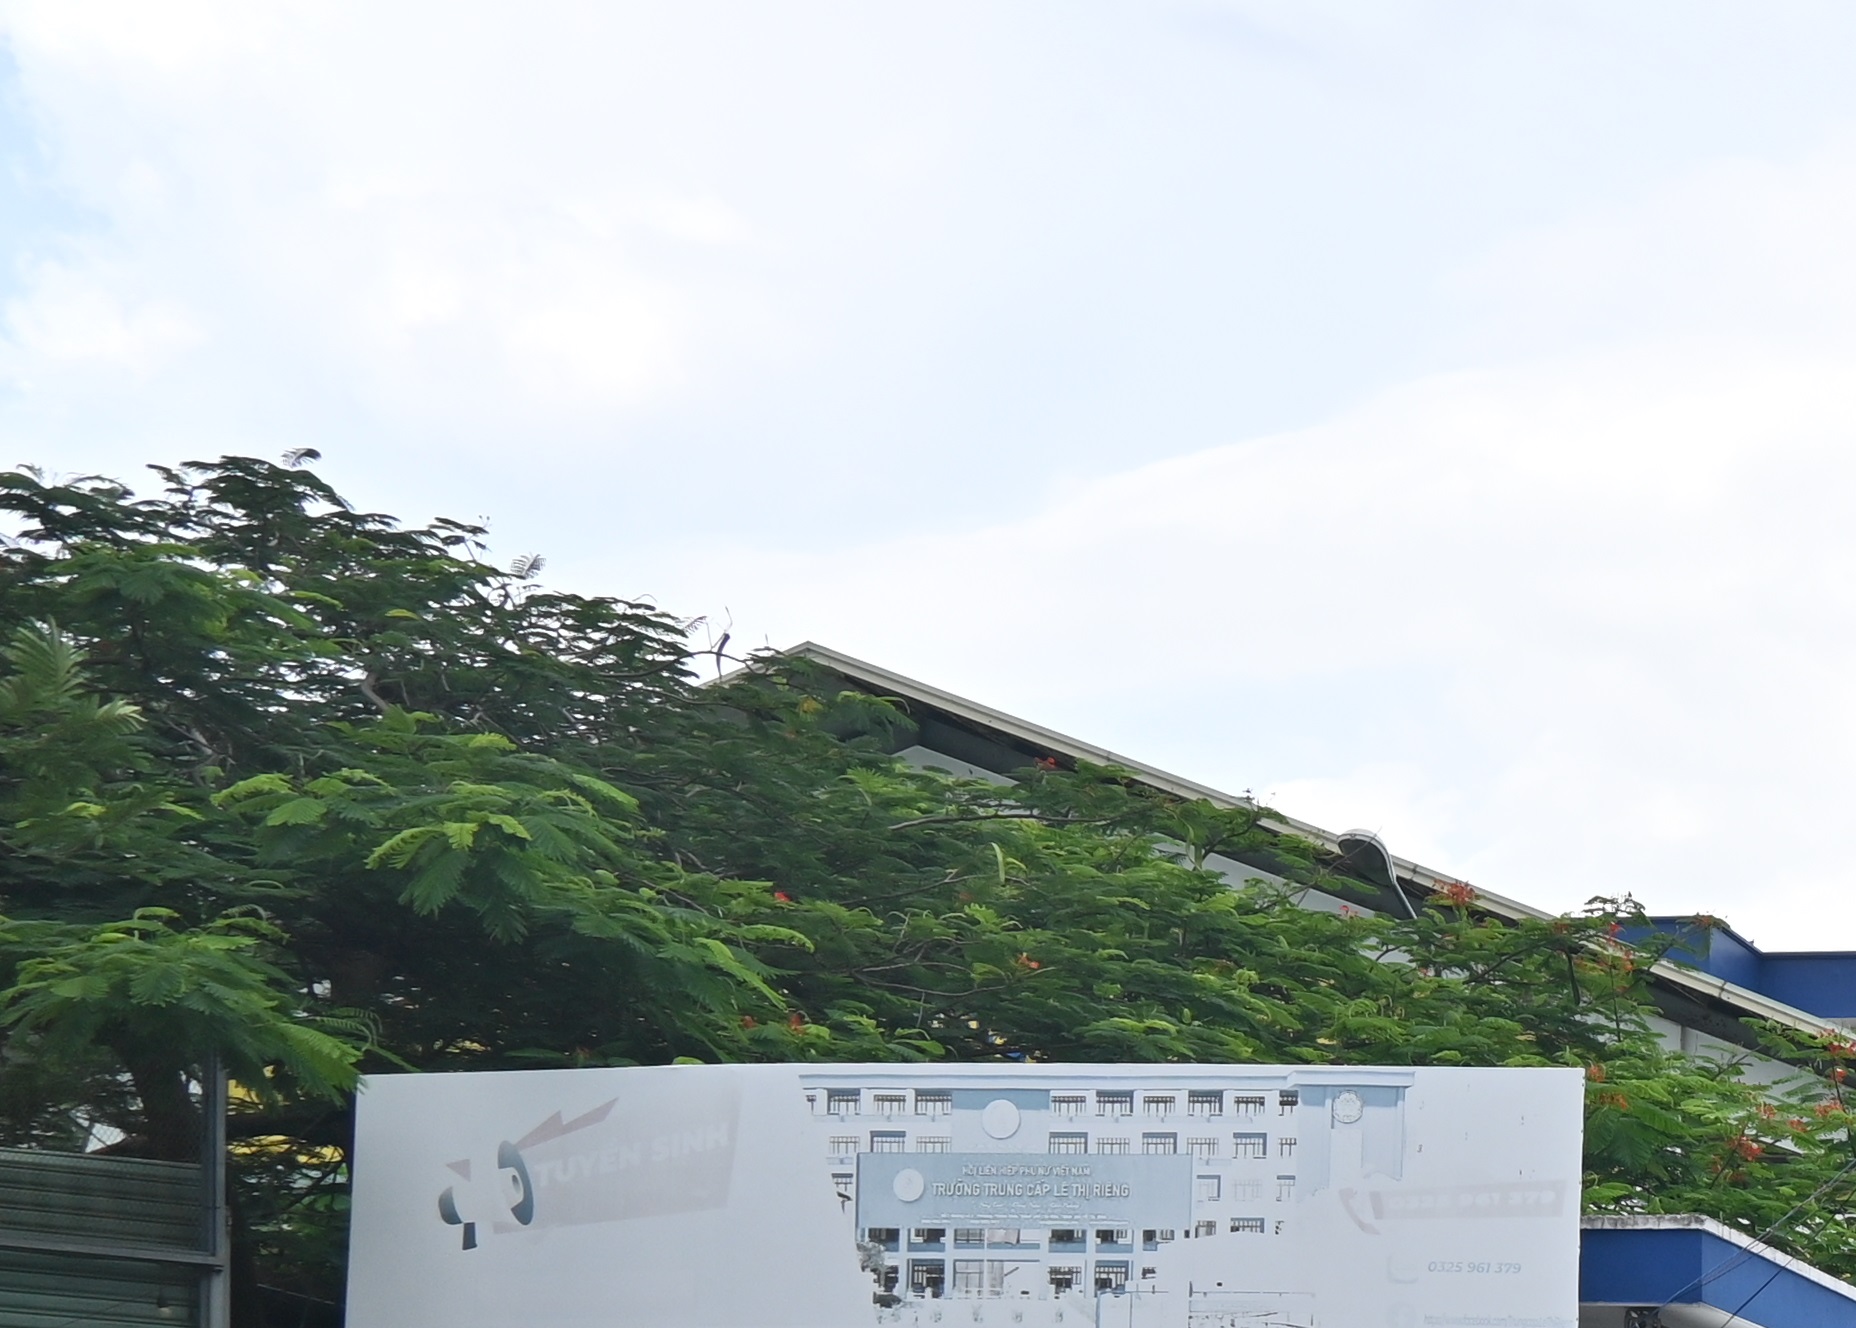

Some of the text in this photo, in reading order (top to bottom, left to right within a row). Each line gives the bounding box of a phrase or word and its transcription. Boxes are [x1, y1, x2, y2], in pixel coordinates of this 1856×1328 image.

[983, 1183, 1022, 1196] TRUNG
[1428, 1261, 1521, 1273] 0325 961 379
